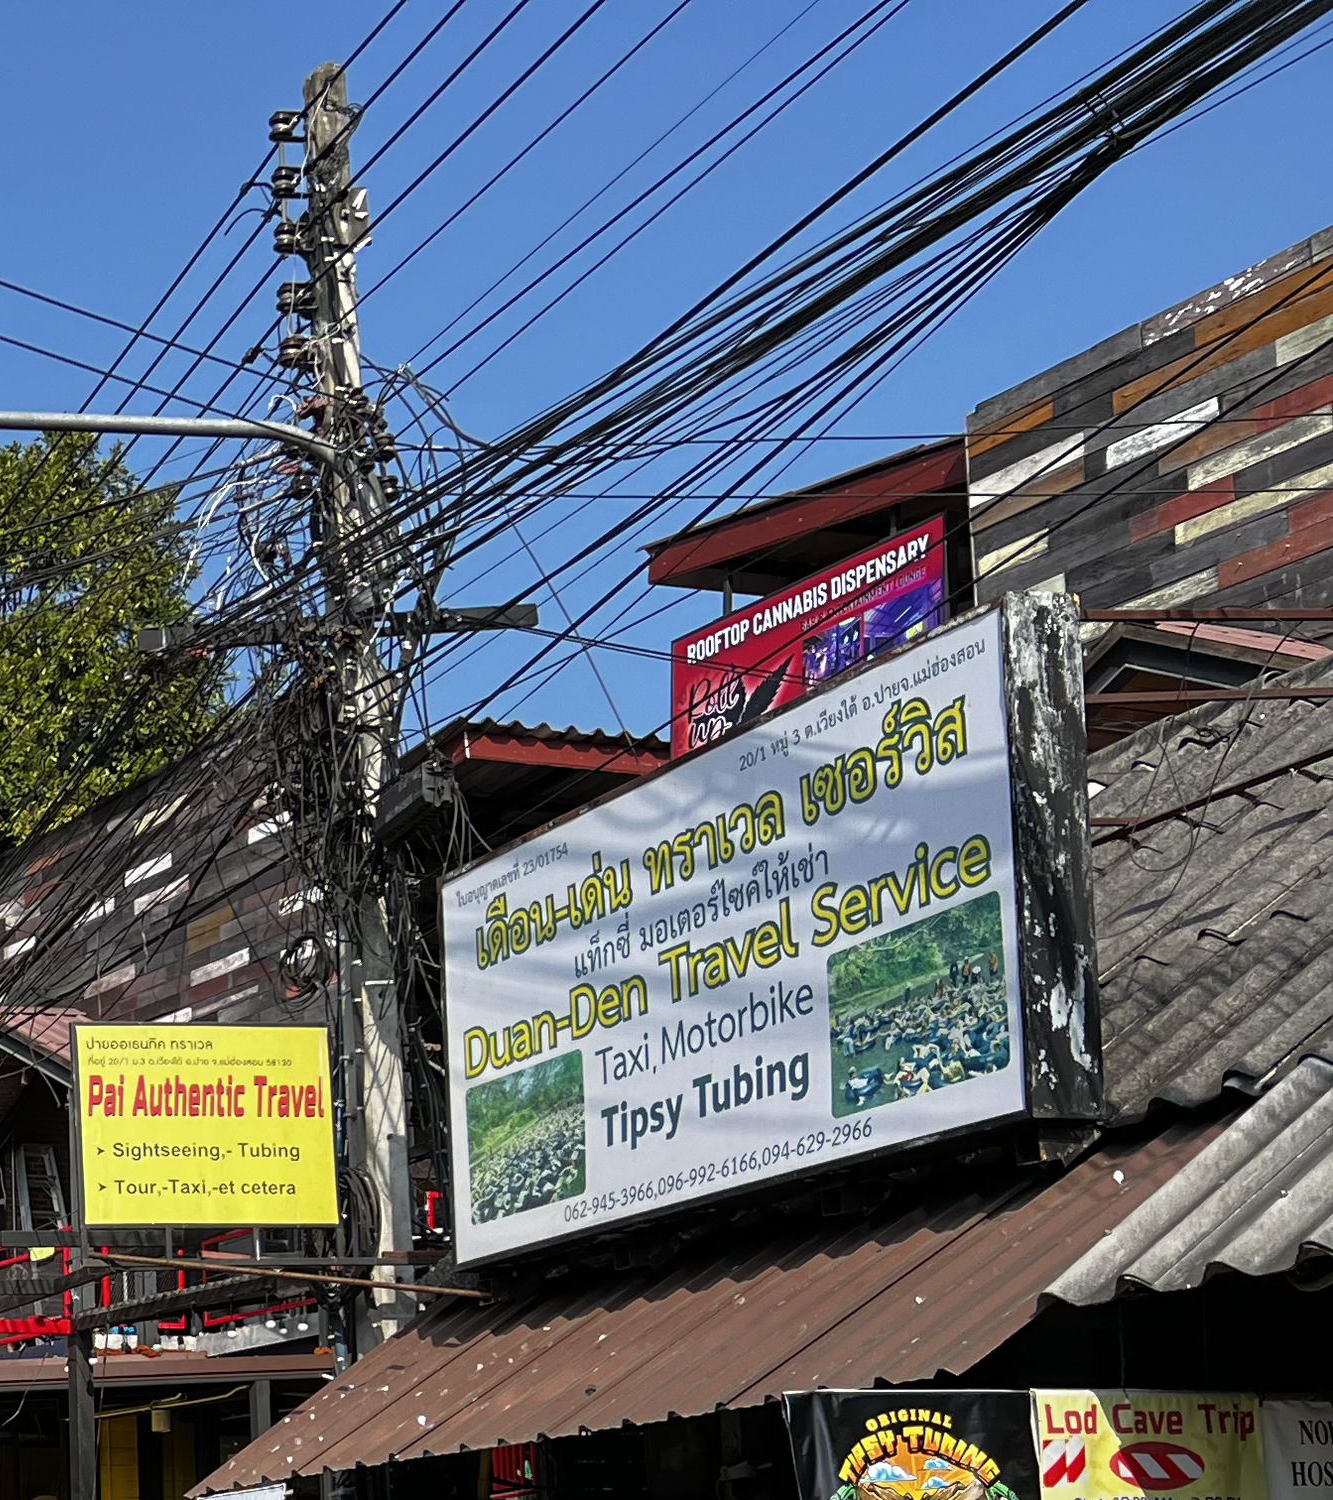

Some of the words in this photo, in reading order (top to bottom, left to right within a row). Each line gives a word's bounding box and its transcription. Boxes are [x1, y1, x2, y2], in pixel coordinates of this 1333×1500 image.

[687, 619, 750, 663] ROOFTOP
[753, 583, 827, 635] CANNABIS
[831, 533, 929, 599] DISPENSARY
[739, 746, 767, 771] 20/1
[792, 729, 801, 746] 3
[475, 850, 633, 970] เดือน-เด่น
[644, 790, 786, 901] ทราเวล
[799, 695, 970, 826] เซอร์วิส
[522, 842, 569, 874] 23/01754
[464, 974, 648, 1081] Duan-Den
[659, 899, 799, 1004] Travel
[811, 834, 990, 949] Service
[574, 913, 632, 978] แท็กซี่
[170, 1040, 213, 1050] ทราเวล
[88, 1074, 124, 1117] Pai
[132, 1074, 245, 1118] Authentic
[254, 1075, 325, 1118] Travel
[601, 1094, 684, 1149] Tipsy
[693, 1052, 811, 1117] Tubing
[238, 1142, 300, 1161] Tubing
[241, 1180, 296, 1195] cetera
[865, 1408, 953, 1431] ORIGINAL
[1045, 1404, 1097, 1434] Lod
[1112, 1403, 1183, 1434] Cave
[1198, 1403, 1255, 1441] Trip
[838, 1429, 898, 1484] TIPSY
[902, 1426, 1001, 1487] TUBING
